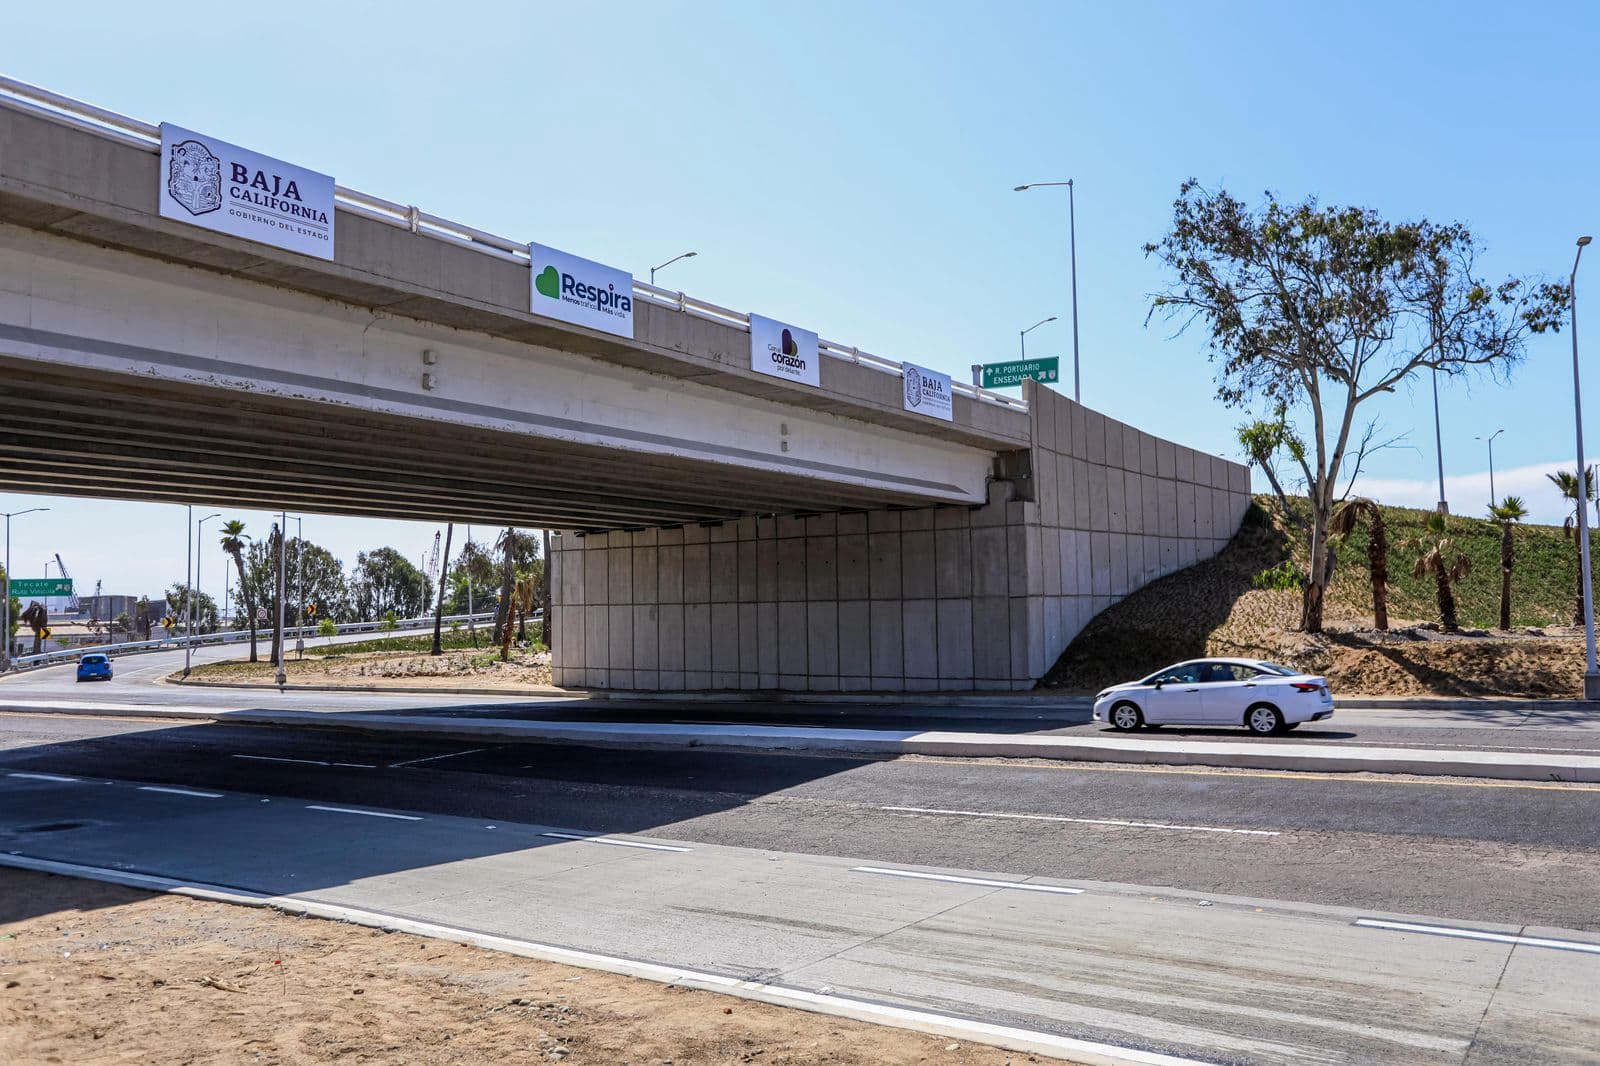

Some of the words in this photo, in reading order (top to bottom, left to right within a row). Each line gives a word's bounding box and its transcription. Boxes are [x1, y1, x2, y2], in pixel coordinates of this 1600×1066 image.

[230, 162, 302, 201] BAJA
[230, 186, 328, 224] CALIFORNIA
[229, 208, 276, 227] GOBIERNO
[278, 222, 294, 232] DEL
[298, 228, 329, 241] ESTADO
[562, 273, 631, 312] Respira
[562, 295, 580, 305] Menos
[767, 343, 777, 352] Con
[771, 352, 806, 370] corazón
[1003, 363, 1040, 374] PORTUARIO
[922, 376, 943, 392] BAJA
[922, 388, 950, 401] CALIFORNIA
